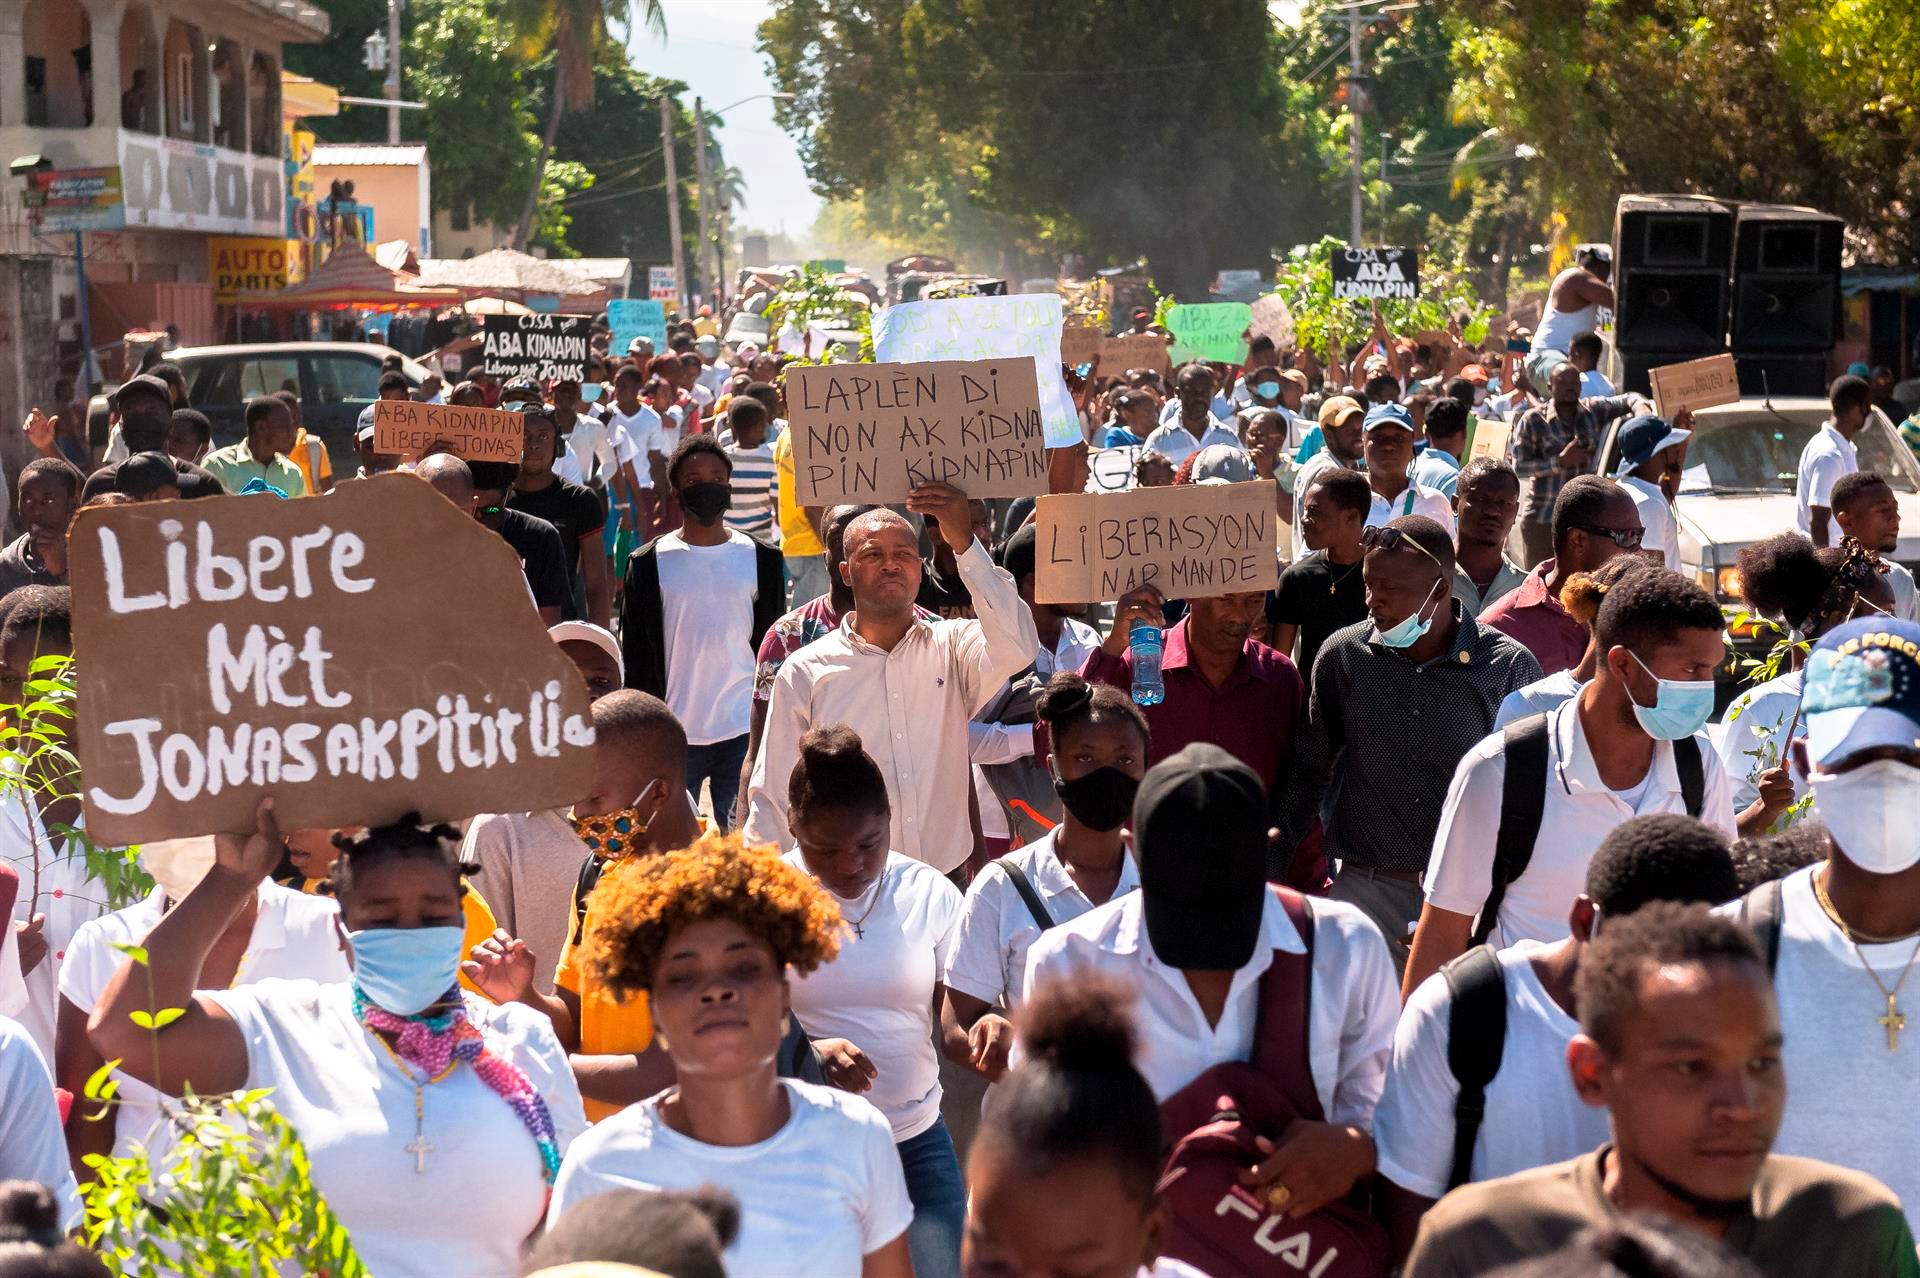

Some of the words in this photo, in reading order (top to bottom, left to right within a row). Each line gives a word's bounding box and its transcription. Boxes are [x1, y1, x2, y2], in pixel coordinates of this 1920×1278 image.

[216, 249, 284, 271] AUTO
[1355, 262, 1405, 282] ABA
[219, 275, 288, 290] PARTS
[1180, 306, 1212, 331] ABA
[484, 332, 523, 358] ABA
[526, 333, 586, 360] KIDNAPIN
[540, 359, 584, 383] JONAS
[801, 371, 937, 413] LAPLÈN
[377, 404, 417, 427] ABA
[455, 434, 517, 457] JONAS
[808, 420, 877, 459] NON
[900, 416, 946, 452] AK
[98, 518, 375, 613] Libere
[1171, 555, 1257, 588] MANDE
[207, 622, 352, 714] Mèt
